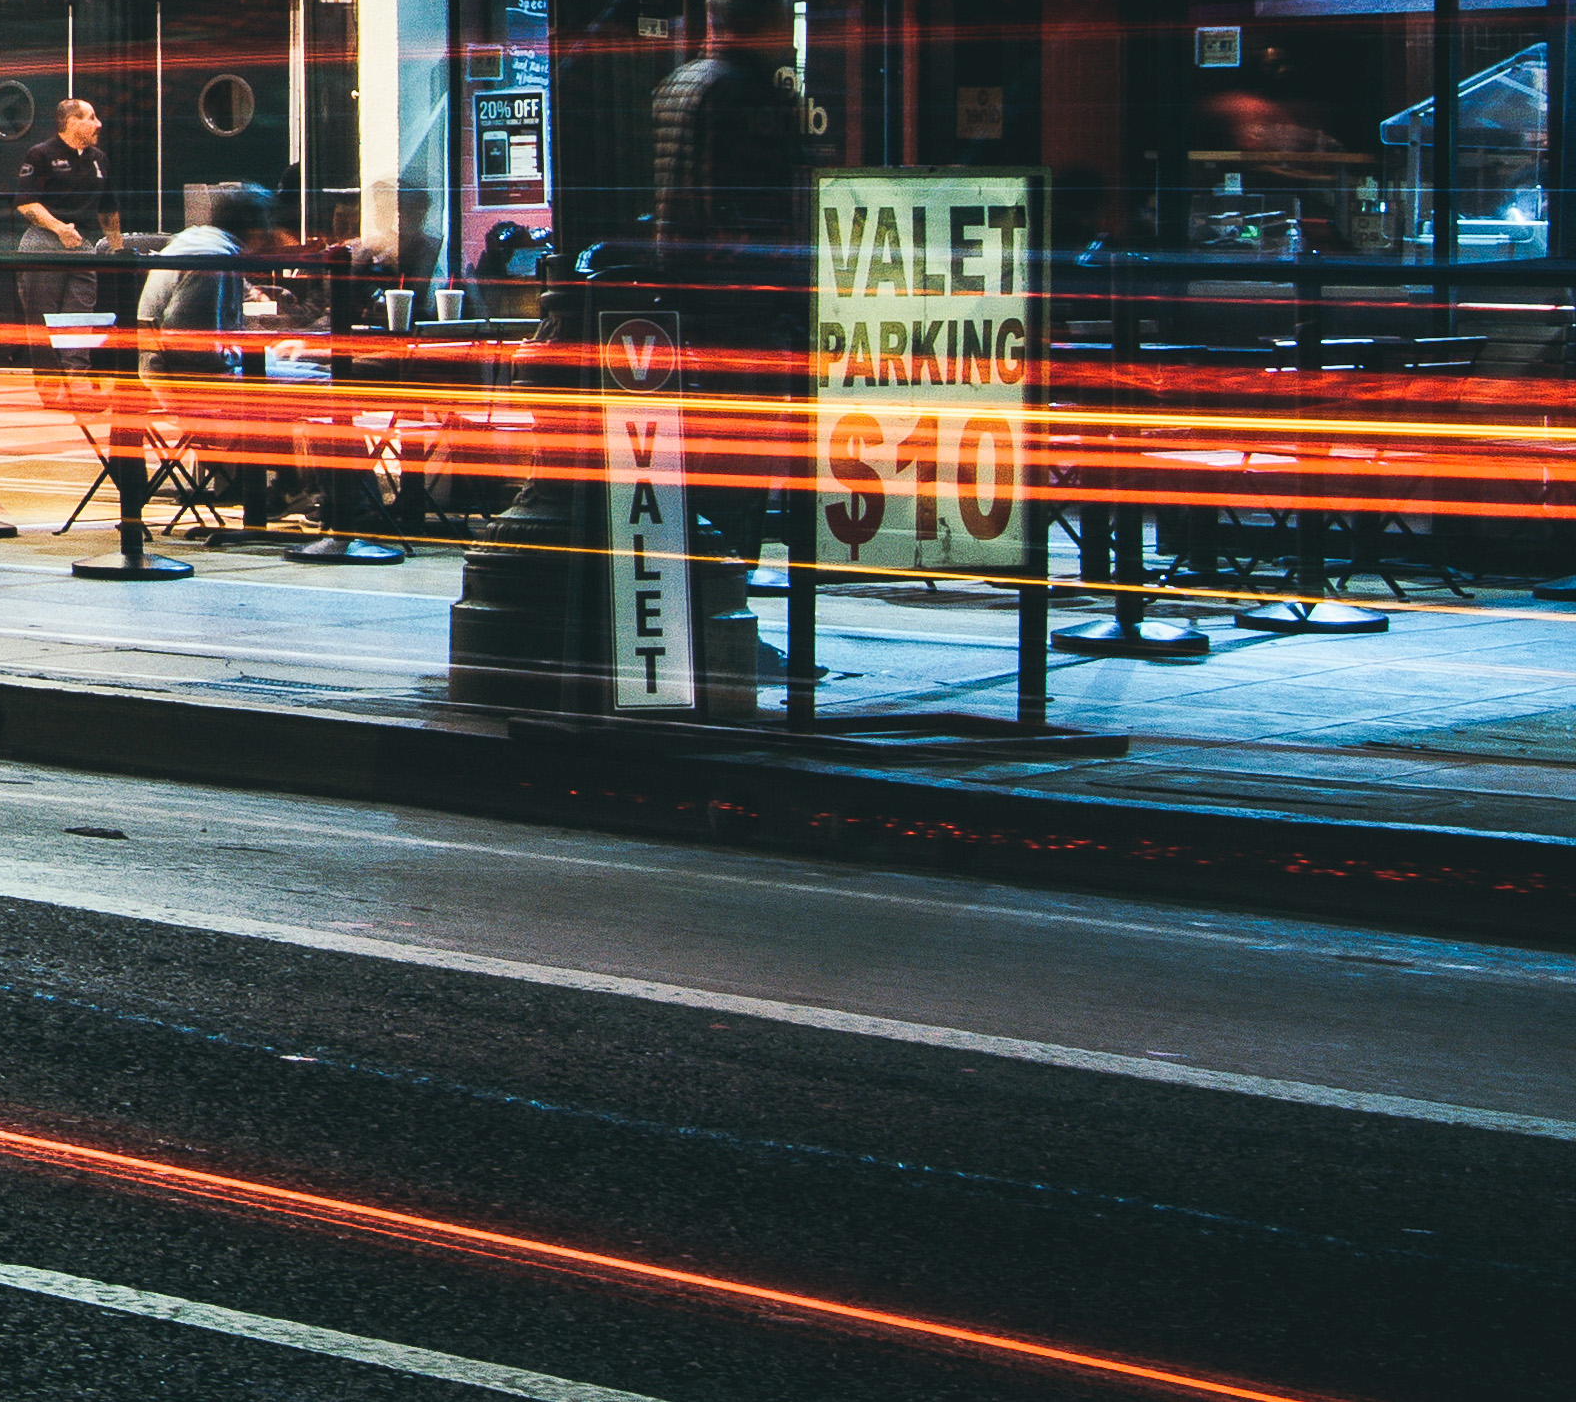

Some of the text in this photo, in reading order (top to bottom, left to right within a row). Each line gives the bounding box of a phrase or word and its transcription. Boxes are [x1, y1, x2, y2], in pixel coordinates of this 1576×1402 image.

[479, 98, 540, 120] 20% OFF
[823, 205, 1027, 299] VALET
[621, 334, 656, 382] V
[818, 317, 1026, 388] PARKING
[824, 410, 1015, 562] $10
[625, 421, 667, 695] VALET
